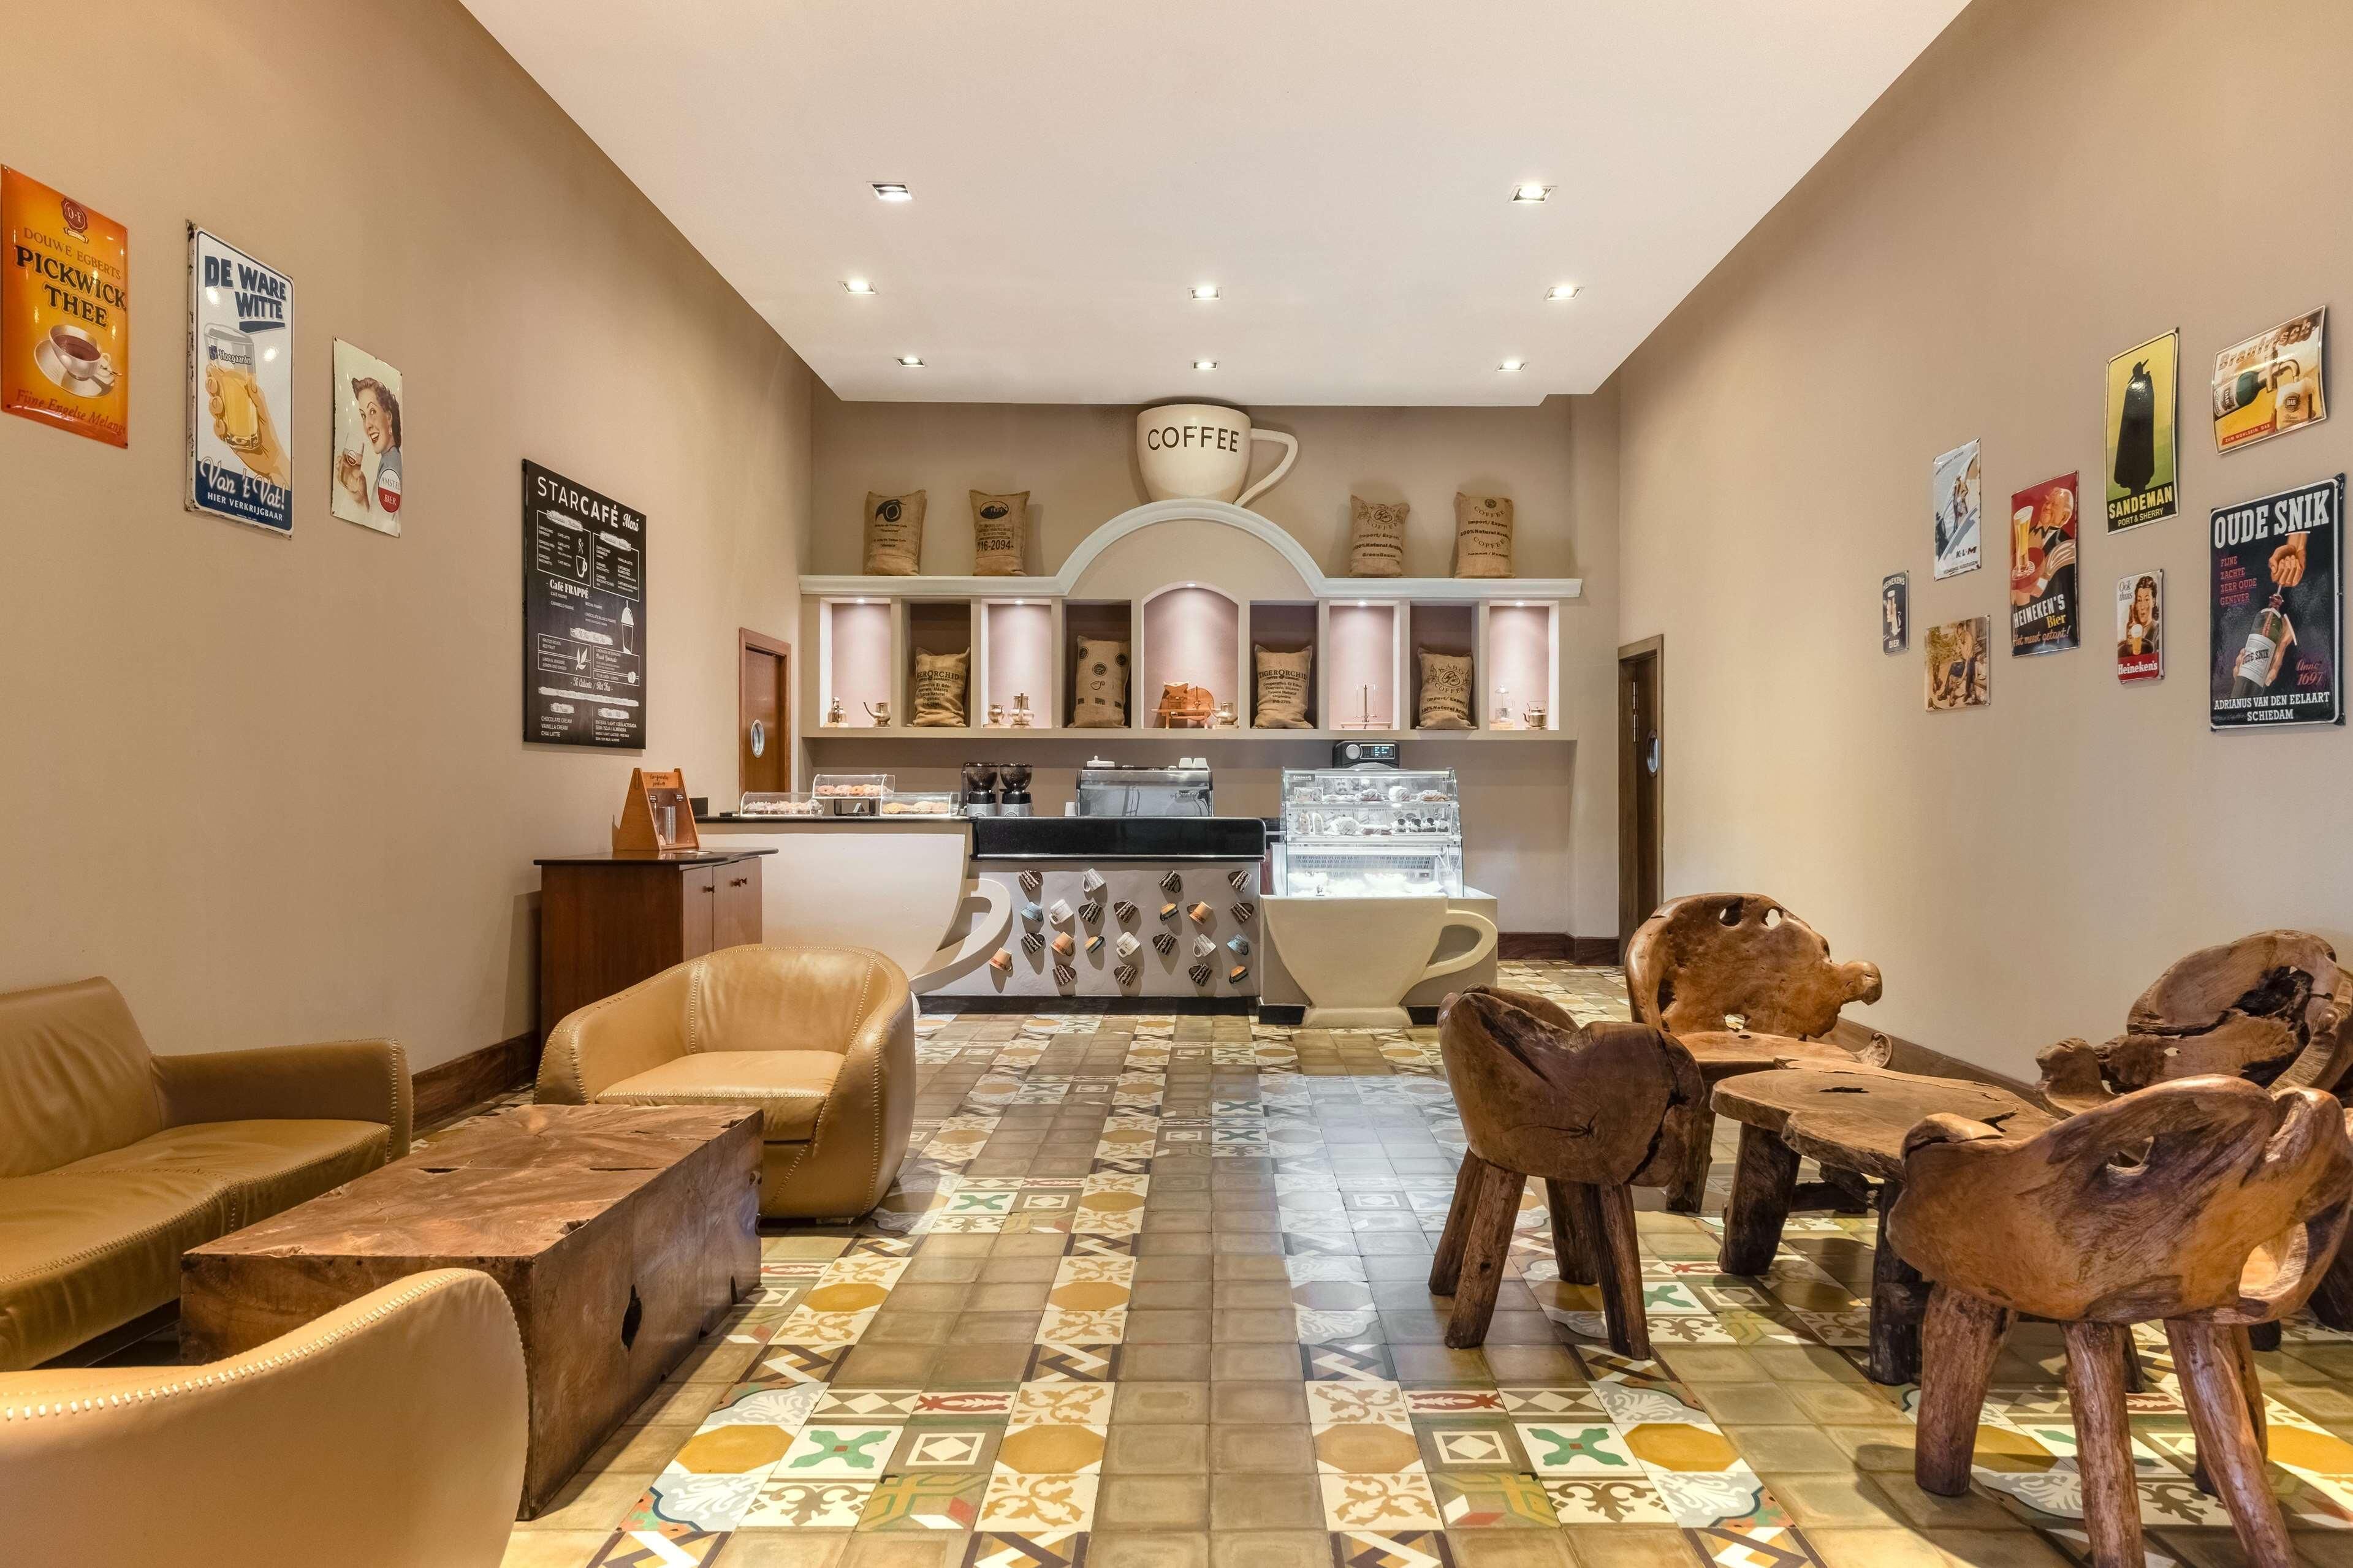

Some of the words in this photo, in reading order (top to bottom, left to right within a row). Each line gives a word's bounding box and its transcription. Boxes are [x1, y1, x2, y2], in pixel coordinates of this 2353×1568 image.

[25, 228, 72, 257] DOUWE
[77, 251, 121, 280] EGBERTS
[15, 245, 126, 308] PICKWICK
[205, 256, 234, 287] DE
[238, 263, 286, 301] WARE
[44, 284, 107, 327] THEE
[234, 291, 283, 319] WITTE
[48, 398, 86, 421] Engelse
[1148, 426, 1239, 453] COFFEE
[200, 456, 235, 494] Van
[253, 474, 285, 510] Vat!
[208, 492, 226, 504] HIER
[229, 498, 283, 521] VERKRIJGBAAR
[384, 494, 397, 506] BIER
[538, 476, 618, 528] STARCAFÉ
[2108, 486, 2173, 520] SANDEMAN
[2118, 516, 2134, 527] PORT
[2134, 513, 2138, 523] &
[2139, 507, 2164, 522] SHERRY
[2214, 504, 2269, 549] OUDE
[2274, 489, 2330, 536] SNIK
[2221, 567, 2246, 580] ZACHTE
[550, 579, 564, 592] Café
[565, 583, 589, 599] FRAPPÉ
[2119, 580, 2131, 592] Ook
[2221, 581, 2237, 593] ZEER
[2238, 578, 2257, 589] OUDE
[2220, 593, 2250, 605] GENEVER
[2013, 594, 2066, 629] HEINEKEN'S
[2046, 614, 2066, 629] Bier
[1888, 639, 1899, 648] BIER
[2118, 661, 2158, 675] Heineken's
[1435, 682, 1465, 694] COFFEE
[2297, 672, 2324, 686] 1697
[2214, 697, 2252, 710] ADRIANUS
[2253, 696, 2268, 707] VAN
[2271, 695, 2287, 706] DEN
[2289, 691, 2330, 705] EELAART
[2247, 709, 2294, 721] SCHIEDAM
